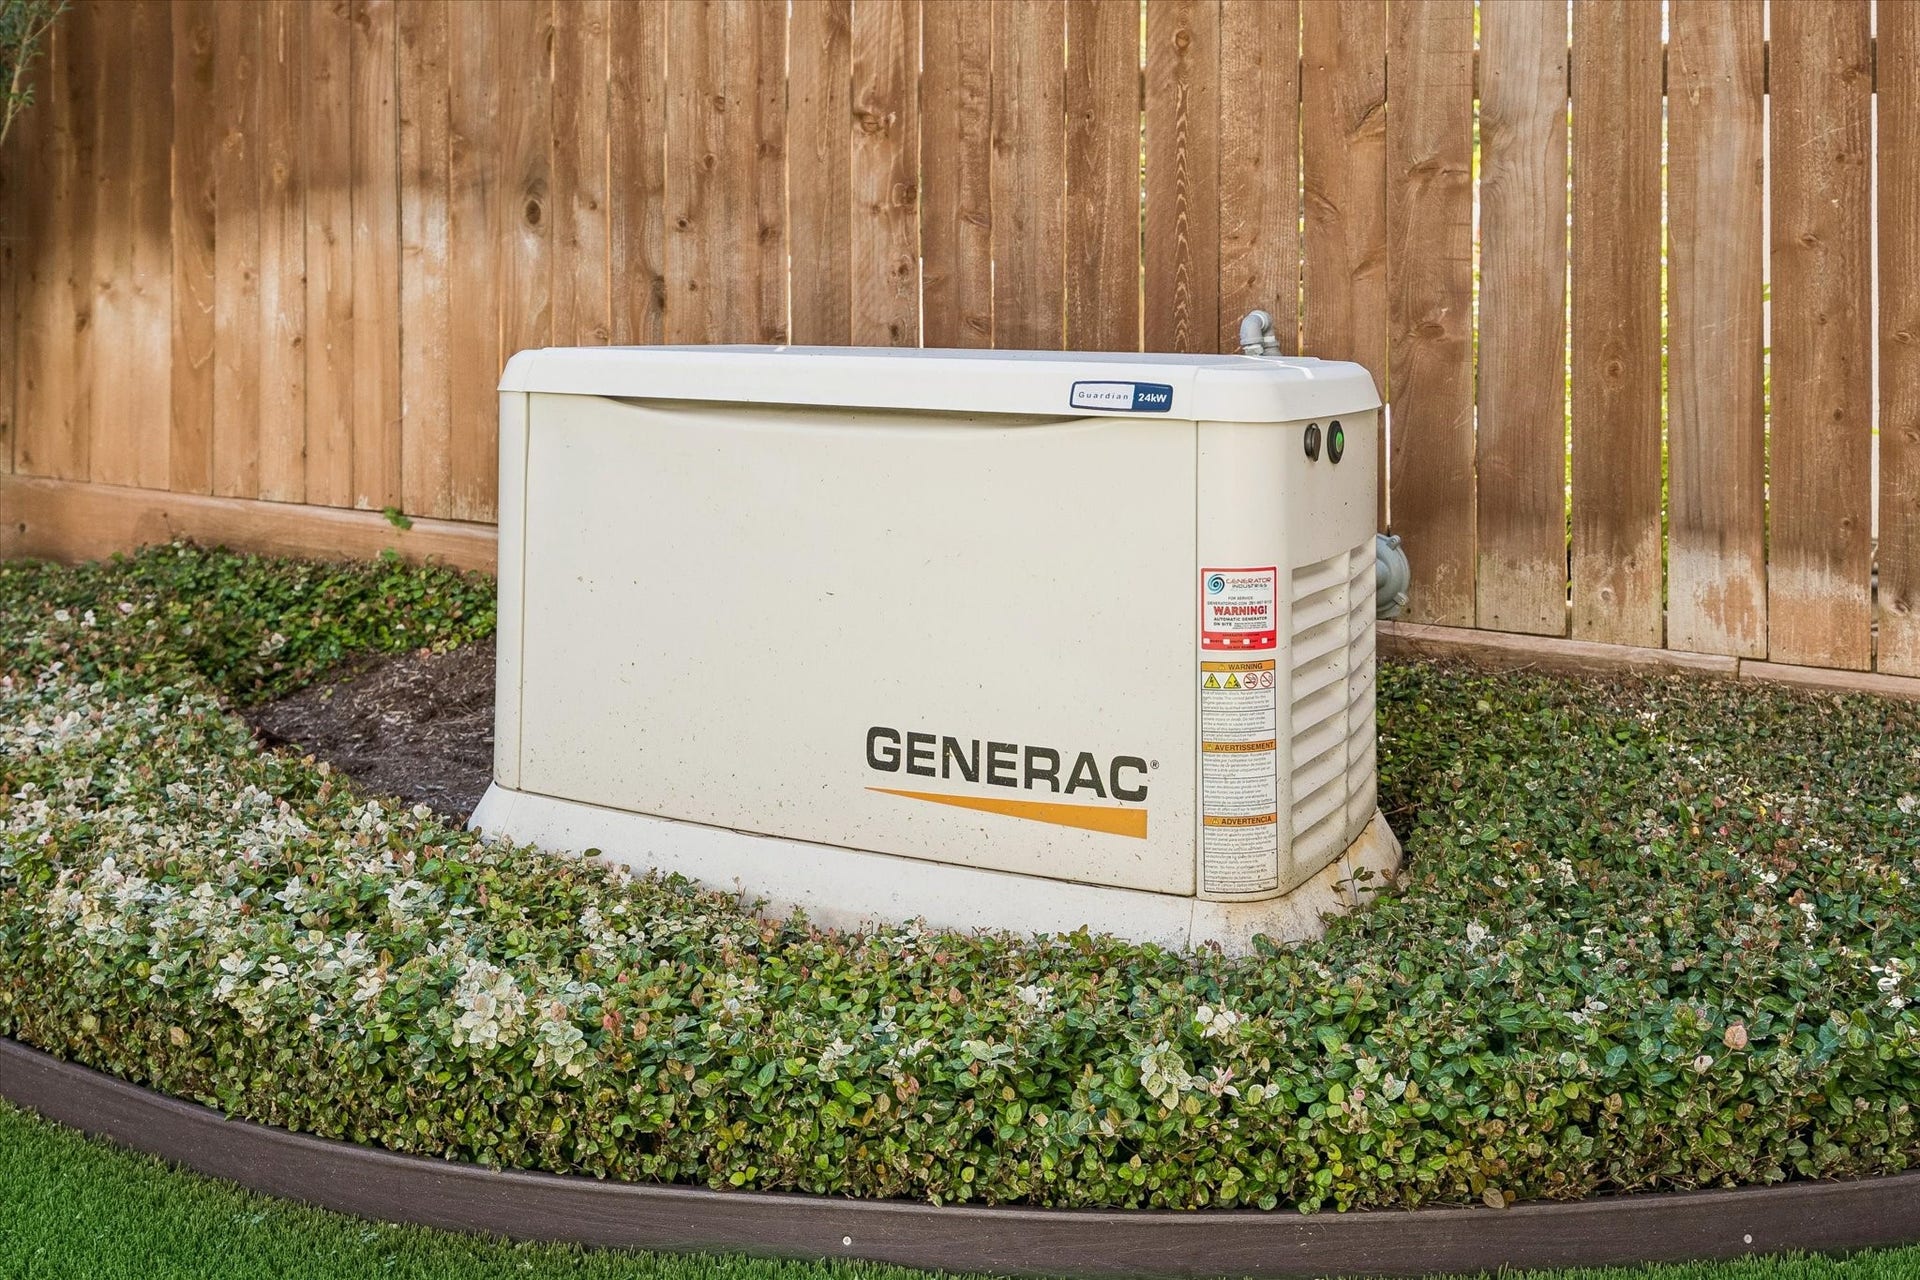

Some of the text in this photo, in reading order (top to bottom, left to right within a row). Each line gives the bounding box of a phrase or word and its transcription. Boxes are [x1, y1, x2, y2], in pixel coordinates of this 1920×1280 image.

[1078, 391, 1168, 403] Guardian 24kW
[1213, 605, 1268, 616] WARNING!
[1214, 741, 1274, 751] AVERTISSEMENT
[1221, 815, 1272, 825] ADVERTENCIA
